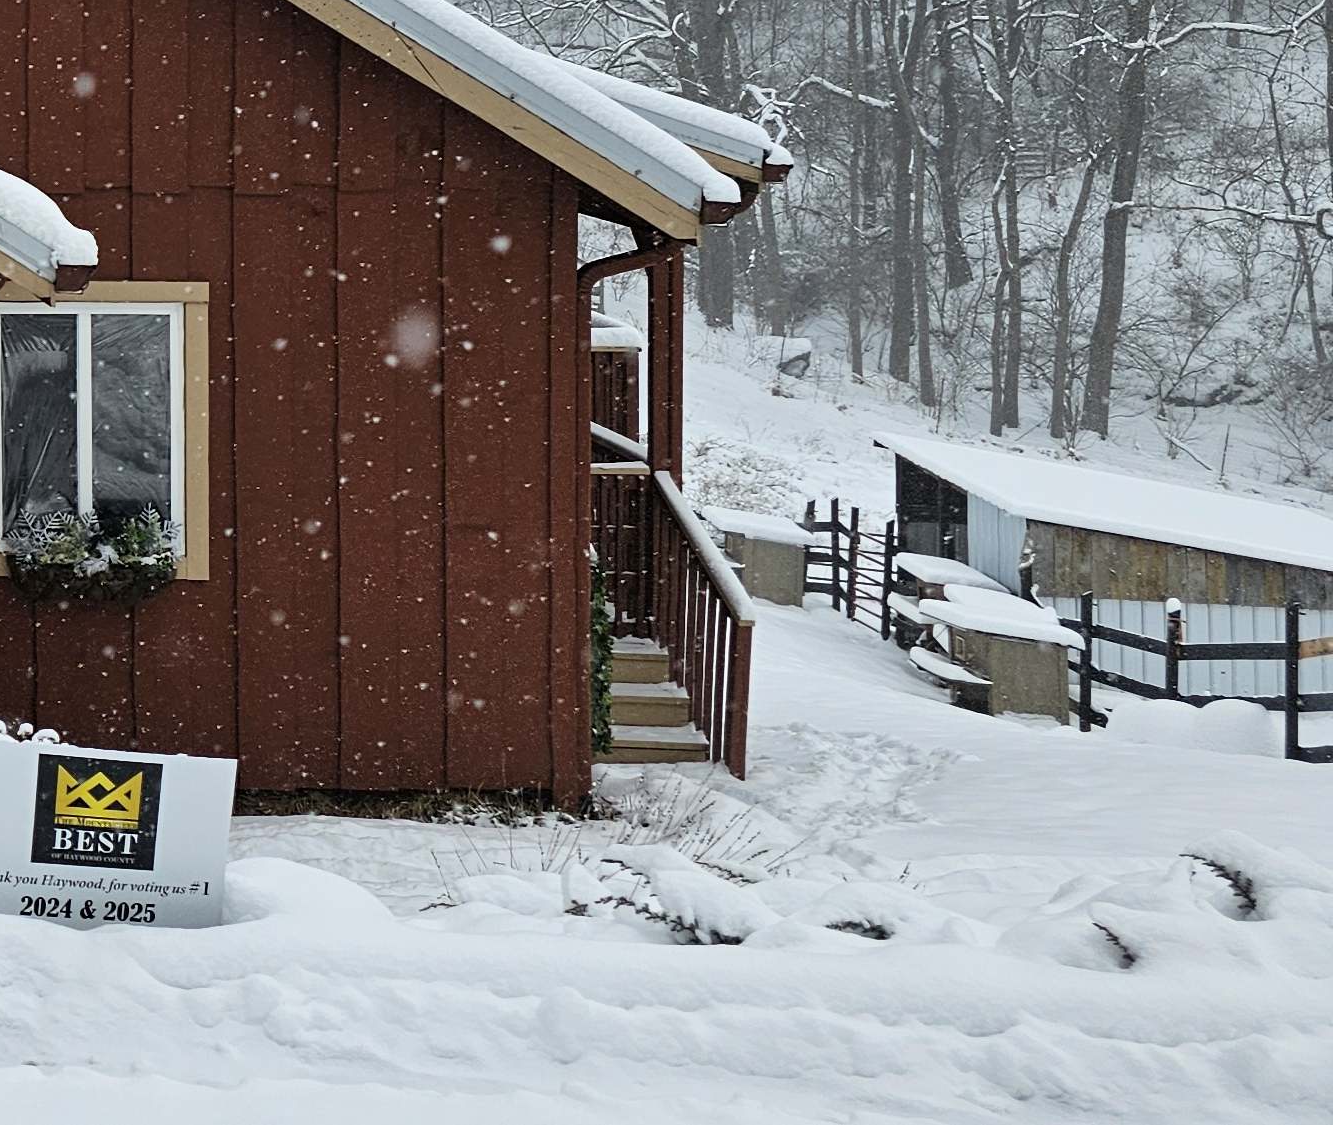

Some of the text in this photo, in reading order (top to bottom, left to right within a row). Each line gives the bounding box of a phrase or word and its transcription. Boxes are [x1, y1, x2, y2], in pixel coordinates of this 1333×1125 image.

[52, 828, 139, 855] BEST
[13, 875, 38, 887] you
[41, 874, 105, 891] Haywood,
[105, 878, 129, 894] for
[130, 882, 170, 897] voting
[172, 885, 187, 895] us
[19, 895, 156, 924] 2024 & 2025
